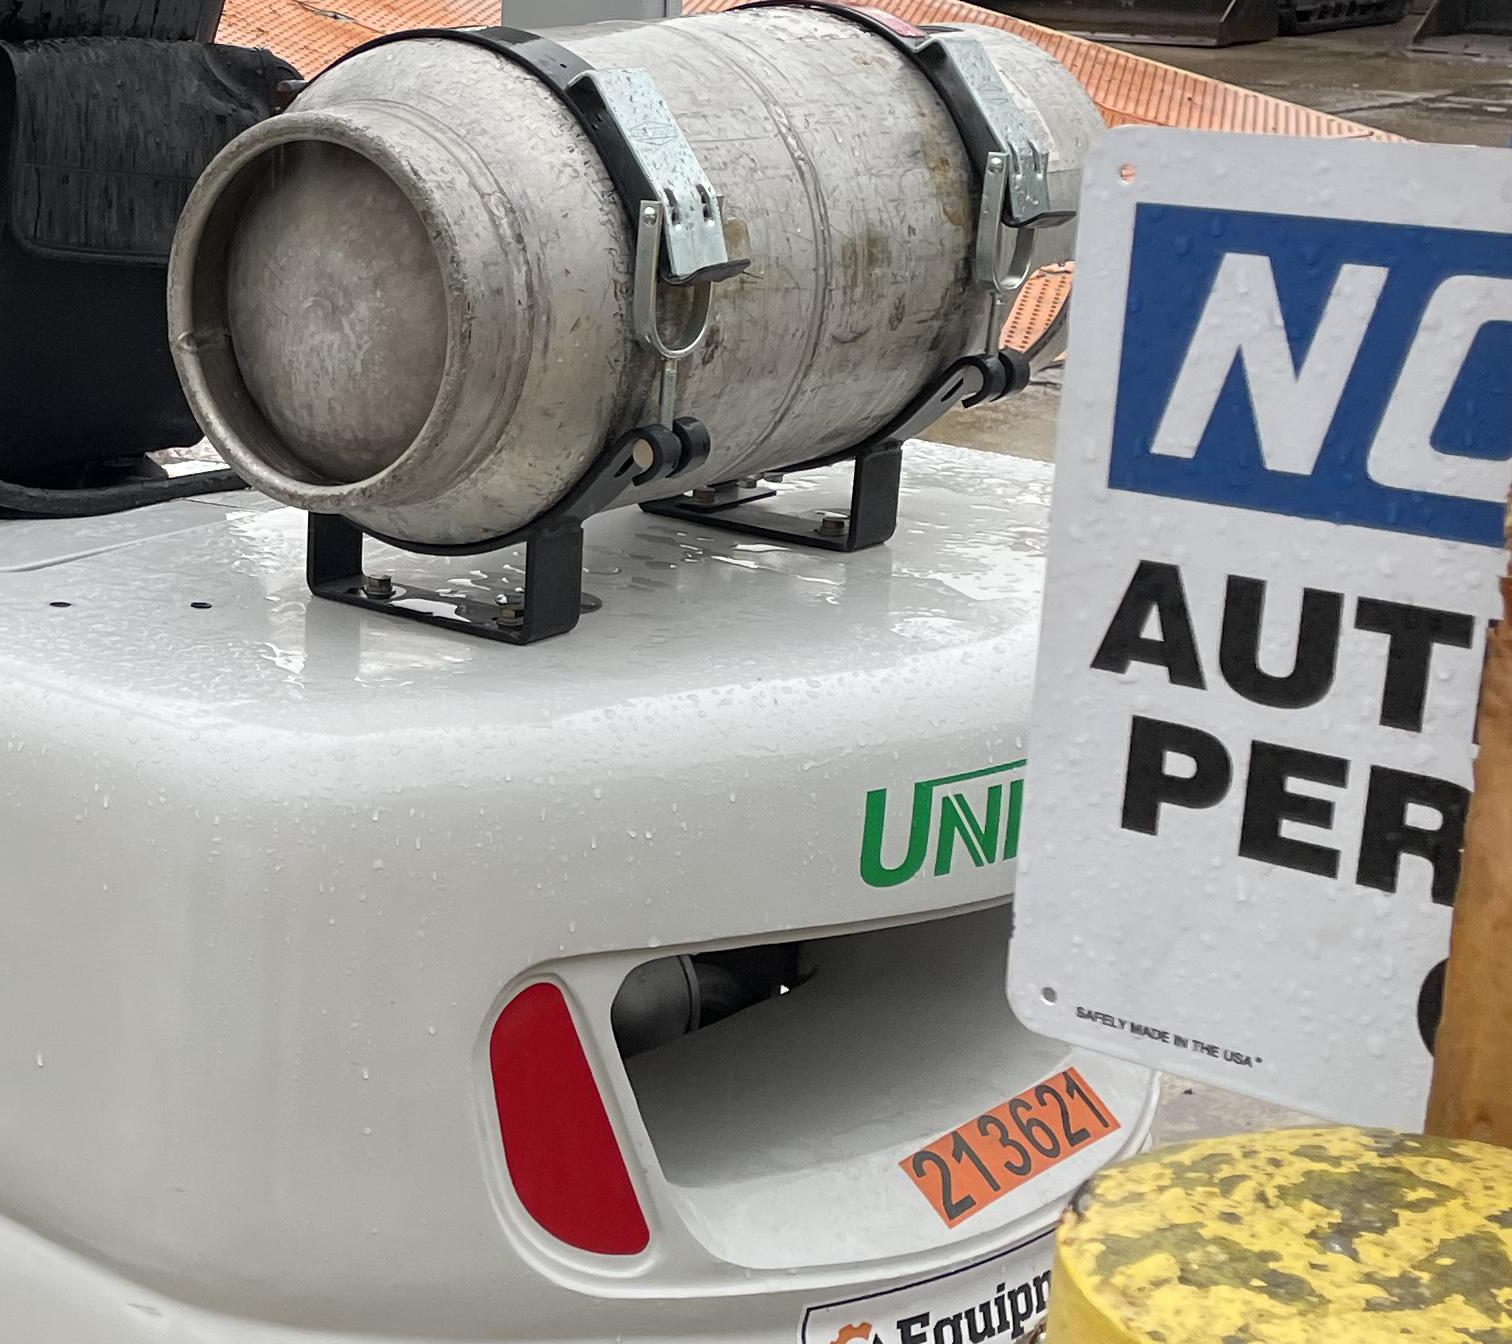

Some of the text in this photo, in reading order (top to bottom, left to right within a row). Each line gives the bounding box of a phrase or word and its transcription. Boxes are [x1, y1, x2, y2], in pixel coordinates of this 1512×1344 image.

[859, 758, 1028, 888] UNI
[1120, 713, 1473, 908] PER
[1076, 1006, 1128, 1030] SAFELY
[1130, 1021, 1170, 1044] MADE
[1173, 1034, 1189, 1049] IN
[1191, 1039, 1220, 1058] THE
[912, 1071, 1110, 1221] 213621
